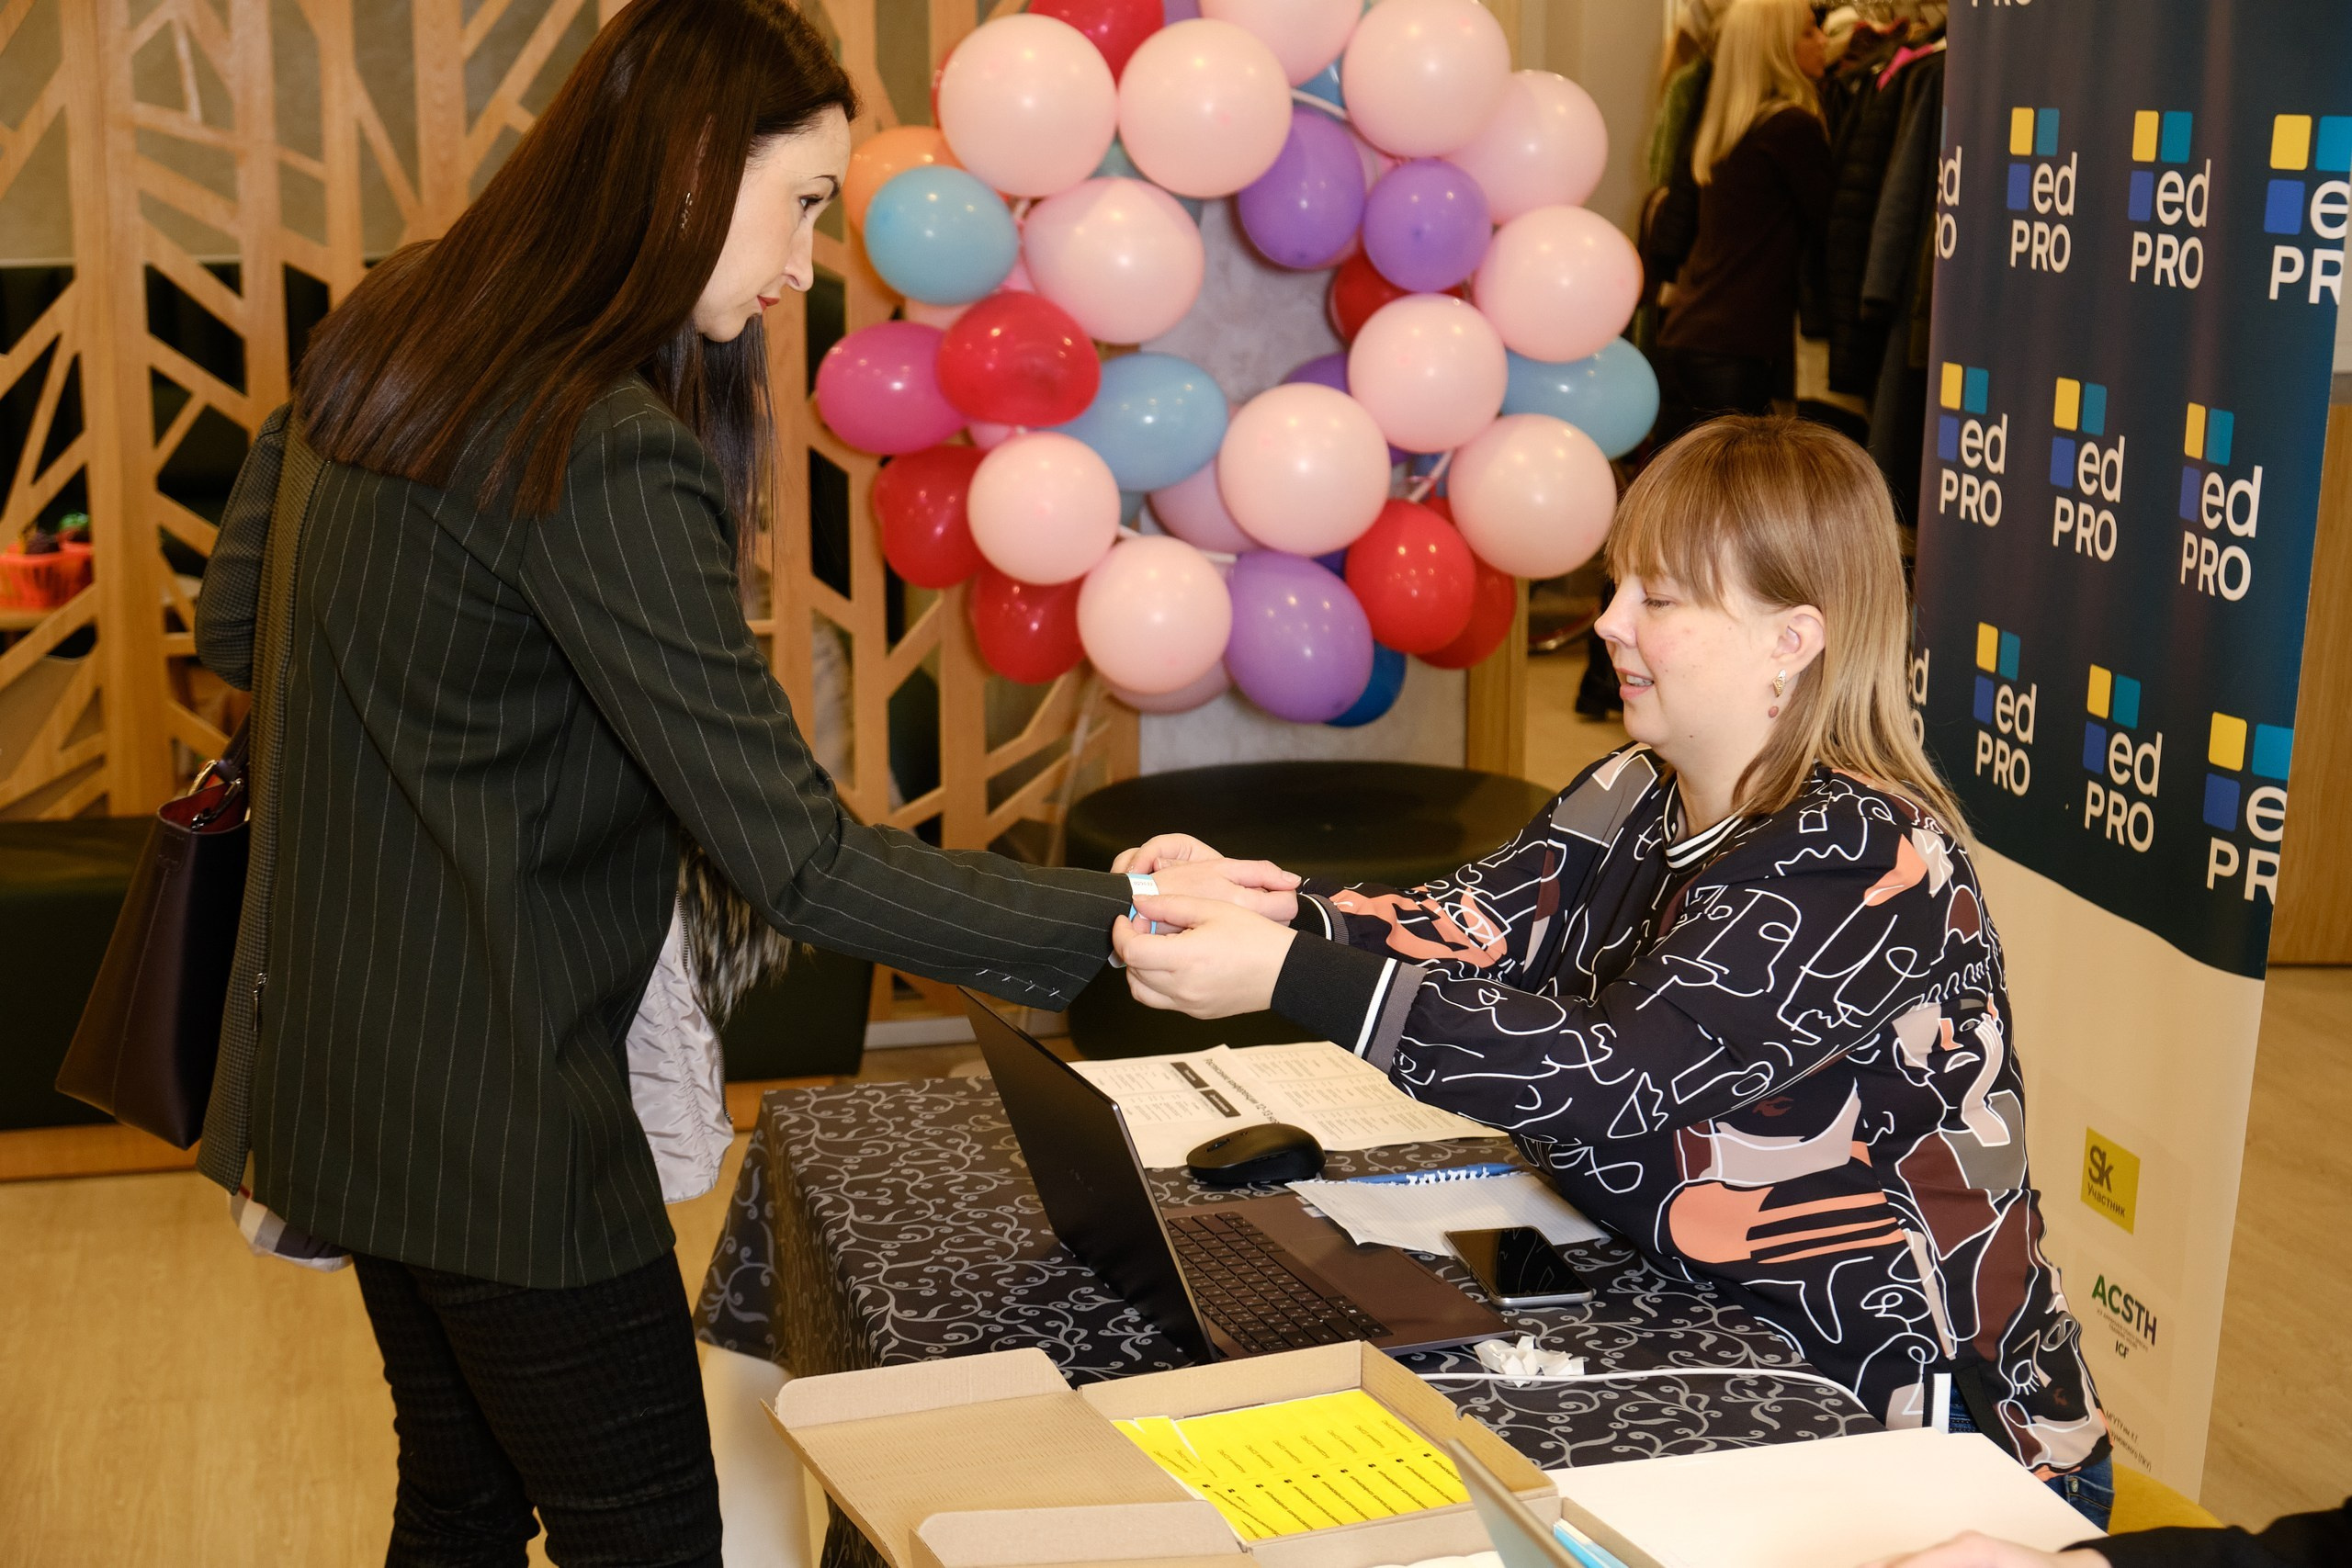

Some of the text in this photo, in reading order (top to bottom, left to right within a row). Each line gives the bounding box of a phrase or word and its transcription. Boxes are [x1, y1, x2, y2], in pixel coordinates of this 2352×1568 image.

[2032, 151, 2077, 217] ed
[2156, 158, 2211, 228] ed
[2310, 180, 2350, 240] e
[2009, 219, 2072, 273] PRO
[2130, 231, 2204, 289] PRO
[2268, 244, 2345, 305] PR
[1960, 412, 2008, 475] ed
[2077, 434, 2126, 503] ed
[1939, 468, 2003, 527] PRO
[2052, 495, 2118, 562] PRO
[2201, 465, 2264, 538] ed
[2180, 529, 2252, 602] PRO
[1996, 682, 2038, 745] ed
[1975, 729, 2031, 796] PRO
[2109, 731, 2163, 797] ed
[2085, 779, 2154, 853] PRO
[2246, 786, 2288, 842] e
[2207, 837, 2280, 906] PR
[2087, 1181, 2125, 1218] Участник
[2088, 1145, 2114, 1193] Sk
[2091, 1274, 2157, 1347] ACSTH
[2115, 1340, 2130, 1359] ICF
